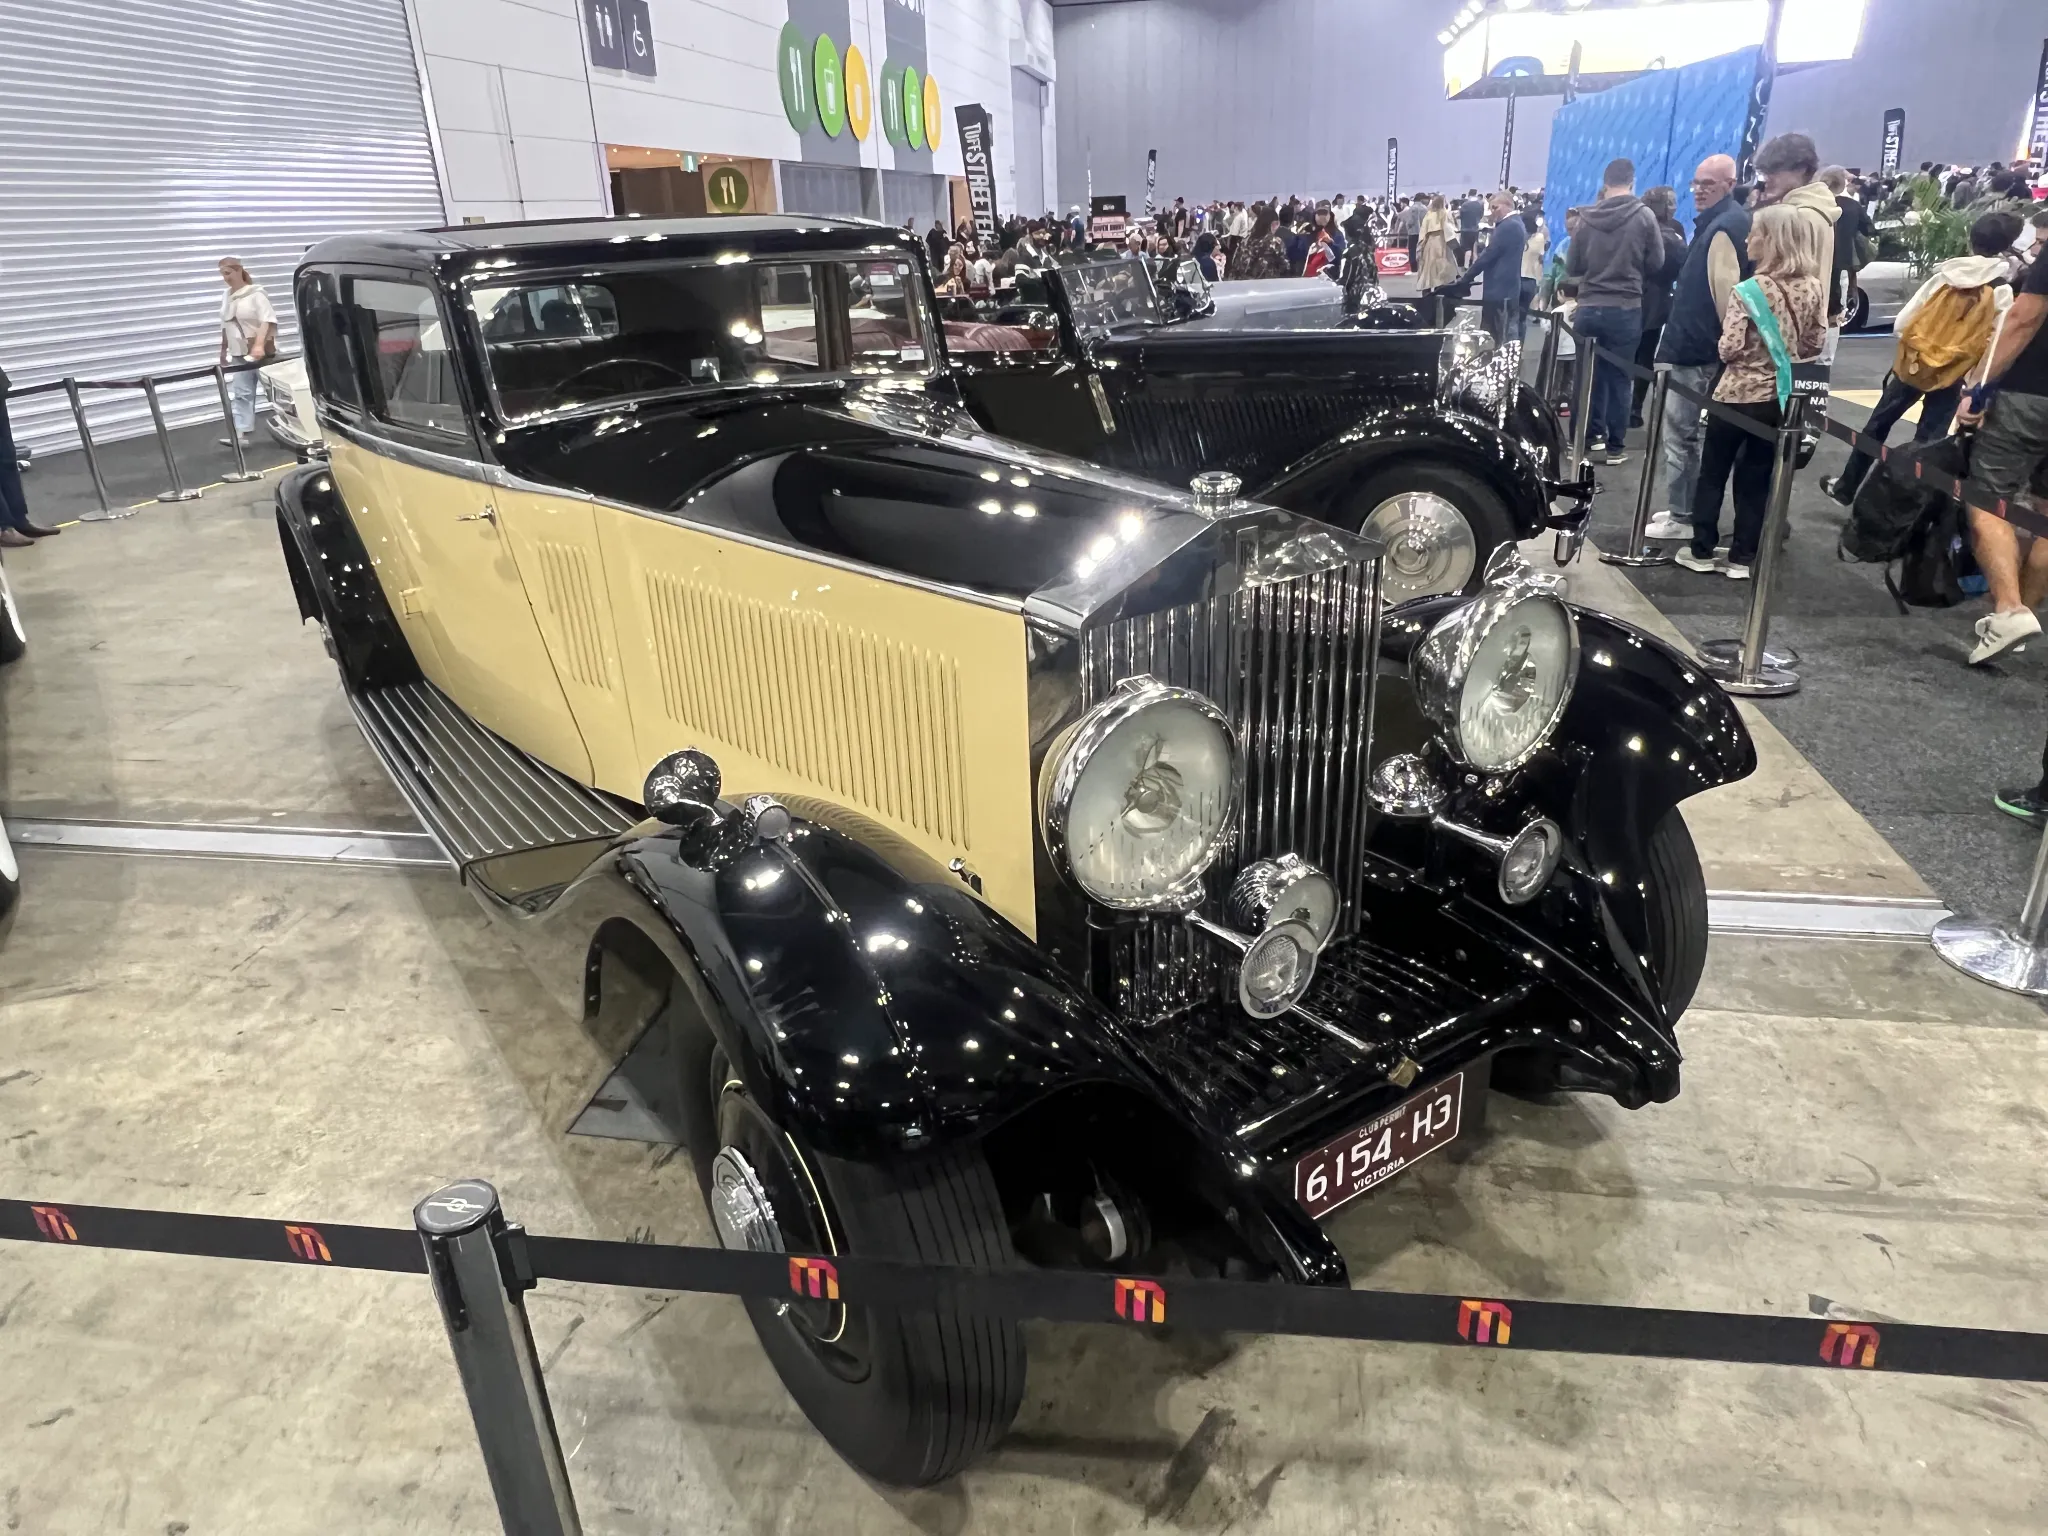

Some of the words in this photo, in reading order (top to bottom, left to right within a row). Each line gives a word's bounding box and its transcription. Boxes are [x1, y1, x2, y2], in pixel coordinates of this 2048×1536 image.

[963, 122, 982, 152] TUFF
[1359, 1123, 1380, 1138] CLUB
[1379, 1106, 1407, 1129] PERMIT
[1353, 1156, 1405, 1191] VICTORIA
